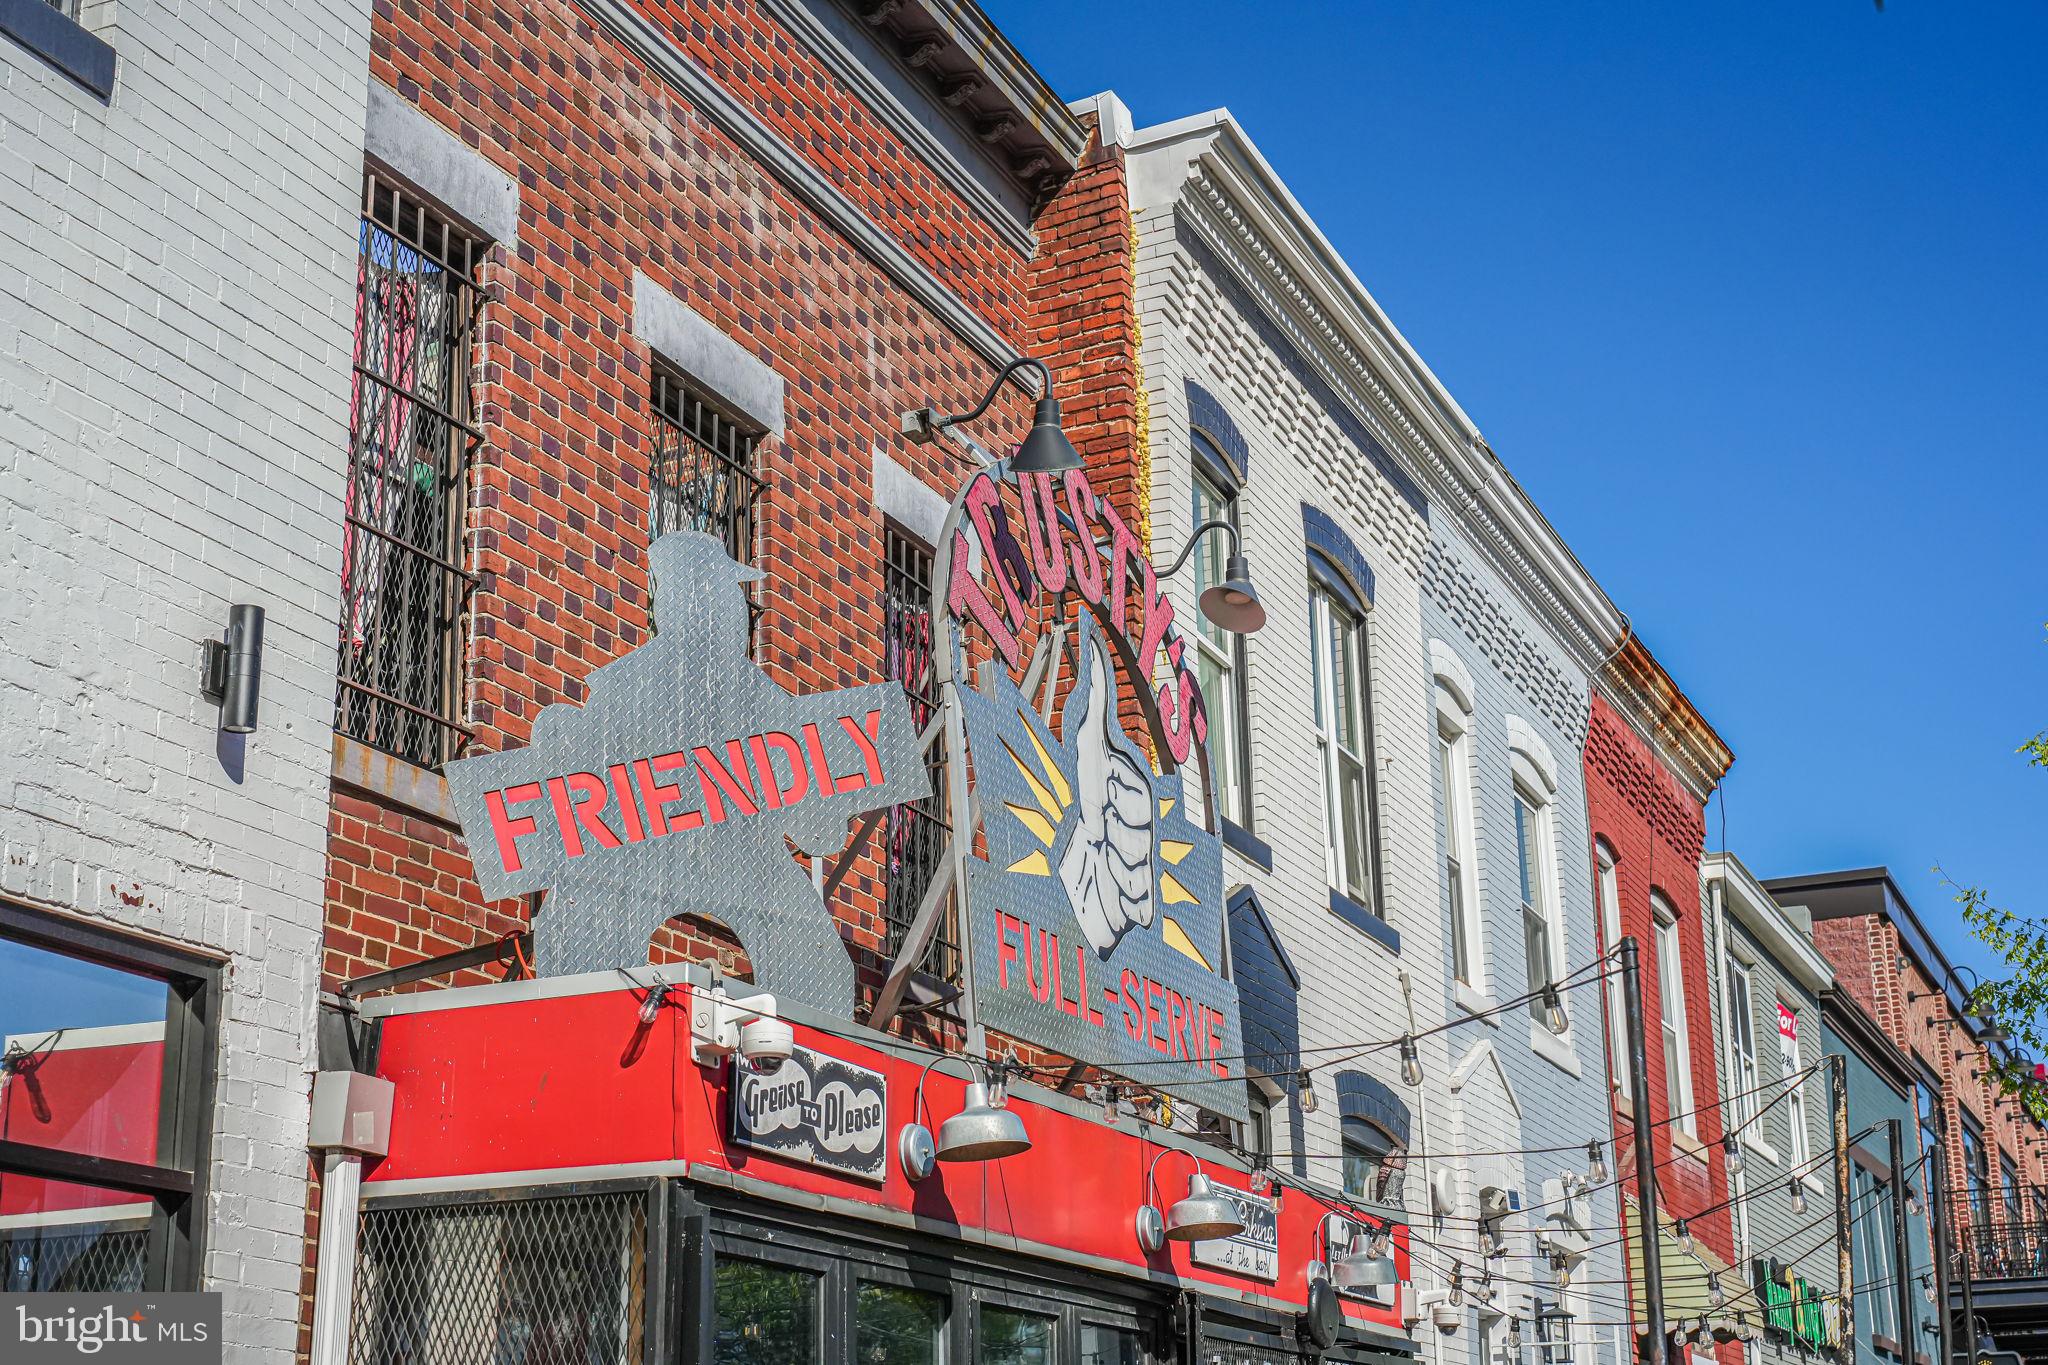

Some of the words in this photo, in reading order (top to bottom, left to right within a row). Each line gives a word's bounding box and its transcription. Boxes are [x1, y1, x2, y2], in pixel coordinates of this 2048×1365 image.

[483, 709, 885, 874] FRIENDLY
[995, 908, 1230, 1079] FULL-SERVE
[744, 1078, 805, 1128] Grease
[804, 1106, 818, 1121] TO
[824, 1090, 881, 1141] Please
[1238, 1245, 1250, 1268] the
